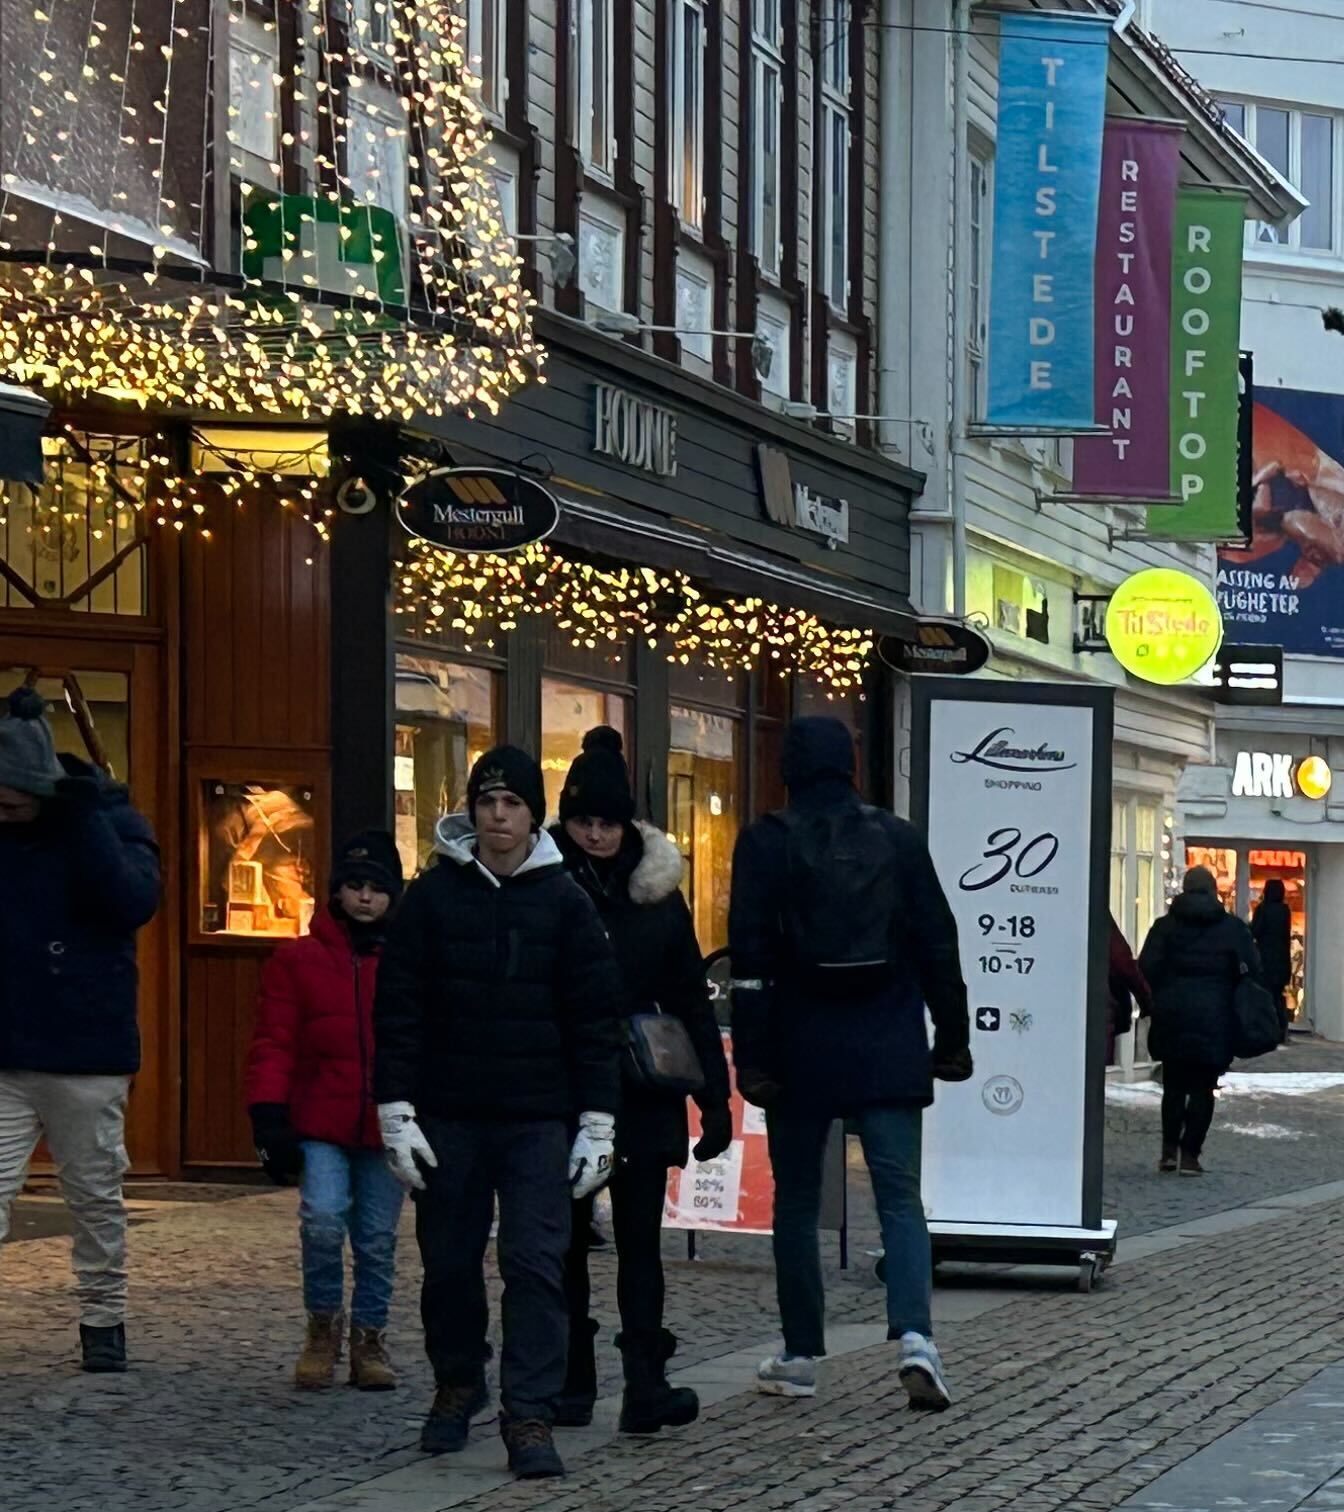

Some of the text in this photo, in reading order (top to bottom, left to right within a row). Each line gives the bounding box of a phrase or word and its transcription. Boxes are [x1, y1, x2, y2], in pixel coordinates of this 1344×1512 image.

[1028, 57, 1065, 390] TILSTEDE
[1112, 160, 1139, 460] RESTAURANT
[1178, 225, 1212, 501] ROOFTOP
[593, 376, 678, 478] HODNE
[433, 503, 524, 526] Mestergull
[984, 777, 1042, 791] SHOPPING
[1232, 752, 1294, 798] ARK
[959, 827, 1059, 891] 30
